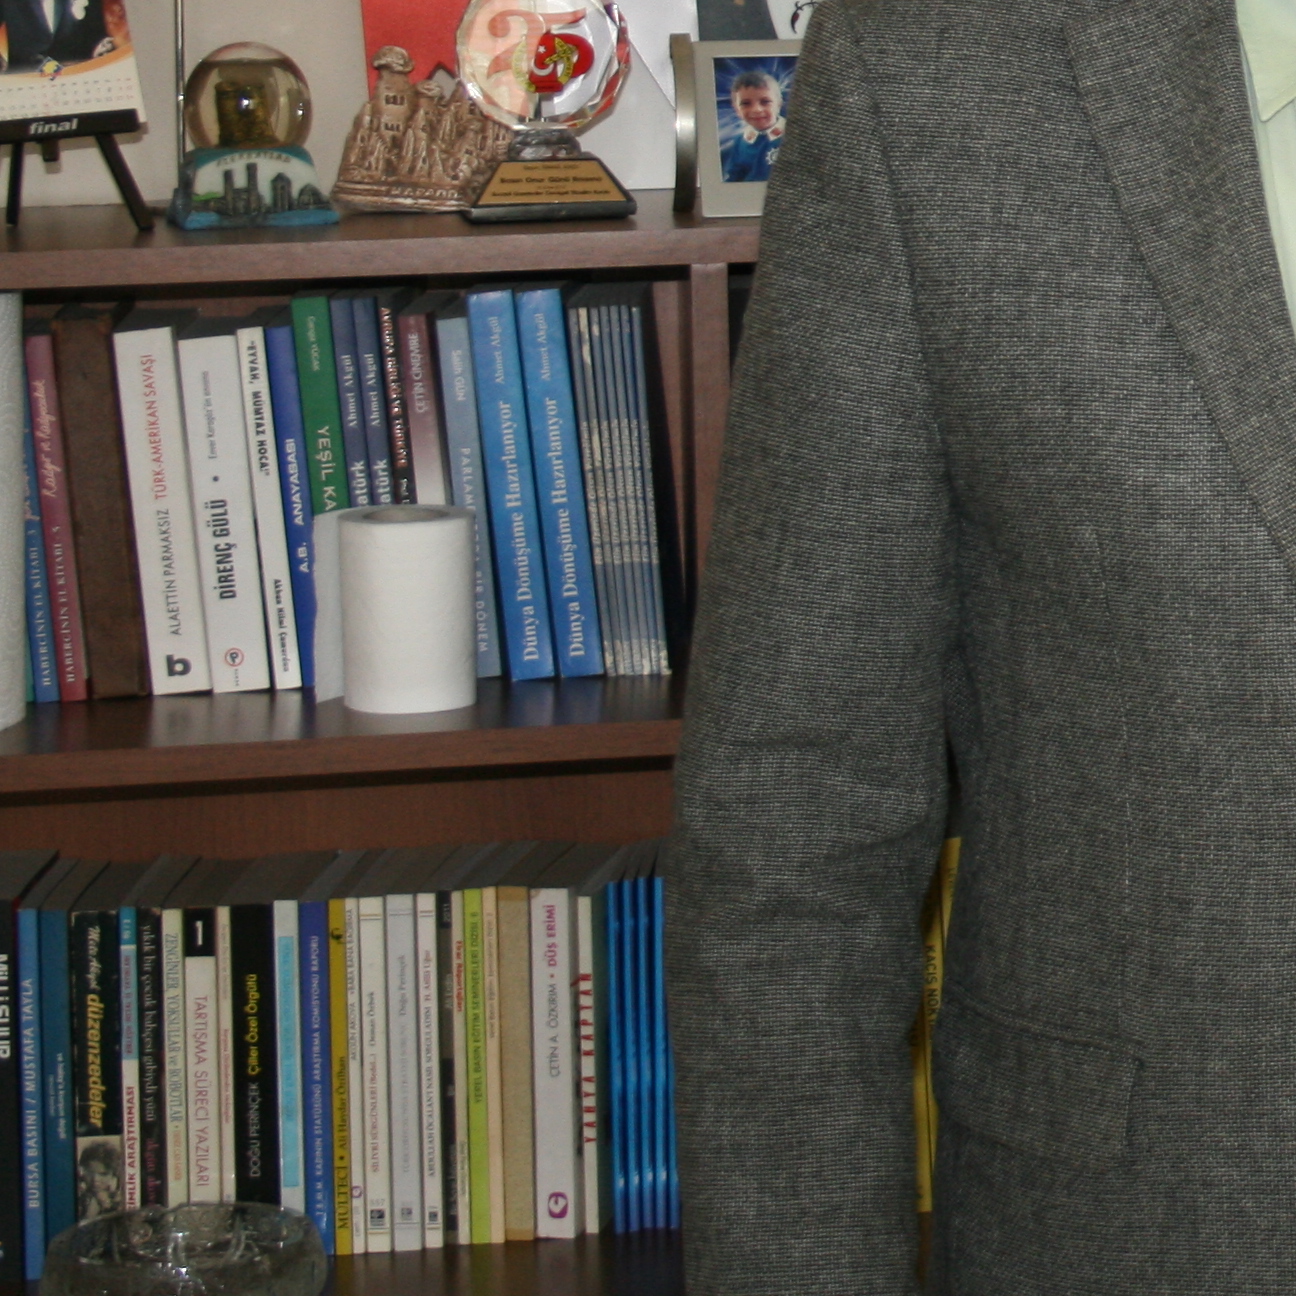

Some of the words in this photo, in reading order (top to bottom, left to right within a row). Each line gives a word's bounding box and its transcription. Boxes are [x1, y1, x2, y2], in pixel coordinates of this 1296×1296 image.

[29, 117, 79, 135] final
[139, 353, 156, 397] SAVAŞI
[540, 347, 552, 382] Ahmet
[250, 390, 268, 436] MÜMTAZ
[347, 392, 359, 429] Ahmet
[369, 391, 381, 427] Ahmet
[453, 377, 467, 402] GÜN
[144, 399, 167, 500] TÜRK-AMERİKAN
[316, 425, 337, 481] YEŞİL
[499, 399, 523, 508] Hazırlanıyor
[544, 396, 569, 505] Hazırlanıyor
[285, 437, 305, 526] ANAYASASI
[155, 508, 175, 576] PARMAKSIZ
[206, 499, 228, 538] GÜLÜ
[29, 547, 43, 588] KİTABI
[53, 542, 67, 584] KİTABI
[214, 542, 238, 600] DİRENÇ
[514, 511, 533, 602] Dönüşüme
[559, 507, 580, 599] Dönüşüme
[164, 579, 182, 636] ALAETTİN
[569, 601, 587, 658] Dünya
[33, 610, 52, 686] HABERCİNİN
[59, 605, 76, 683] HABERCİNİN
[523, 606, 540, 661] Dünya
[142, 924, 156, 952] yıkık
[542, 904, 556, 938] ERİMİ
[143, 955, 156, 972] bir
[544, 942, 560, 967] DÜŞ
[21, 978, 33, 1022] TAYLA
[544, 983, 559, 1029] ÖZKIRIM
[142, 1010, 158, 1053] bahçesi
[192, 995, 209, 1065] TARTIŞMA
[23, 1028, 37, 1092] MUSTAFA
[86, 994, 104, 1127] düzenzedeler
[143, 1055, 158, 1094] gibiydi
[548, 1047, 562, 1078] ÇETİN
[194, 1070, 211, 1121] SÜRECİ
[582, 1076, 597, 1143] YAHYA
[26, 1115, 39, 1160] BASINI
[125, 1086, 137, 1169] ARAŞTIRMASI
[195, 1125, 210, 1187] YAZILARI
[27, 1167, 41, 1209] BURSA
